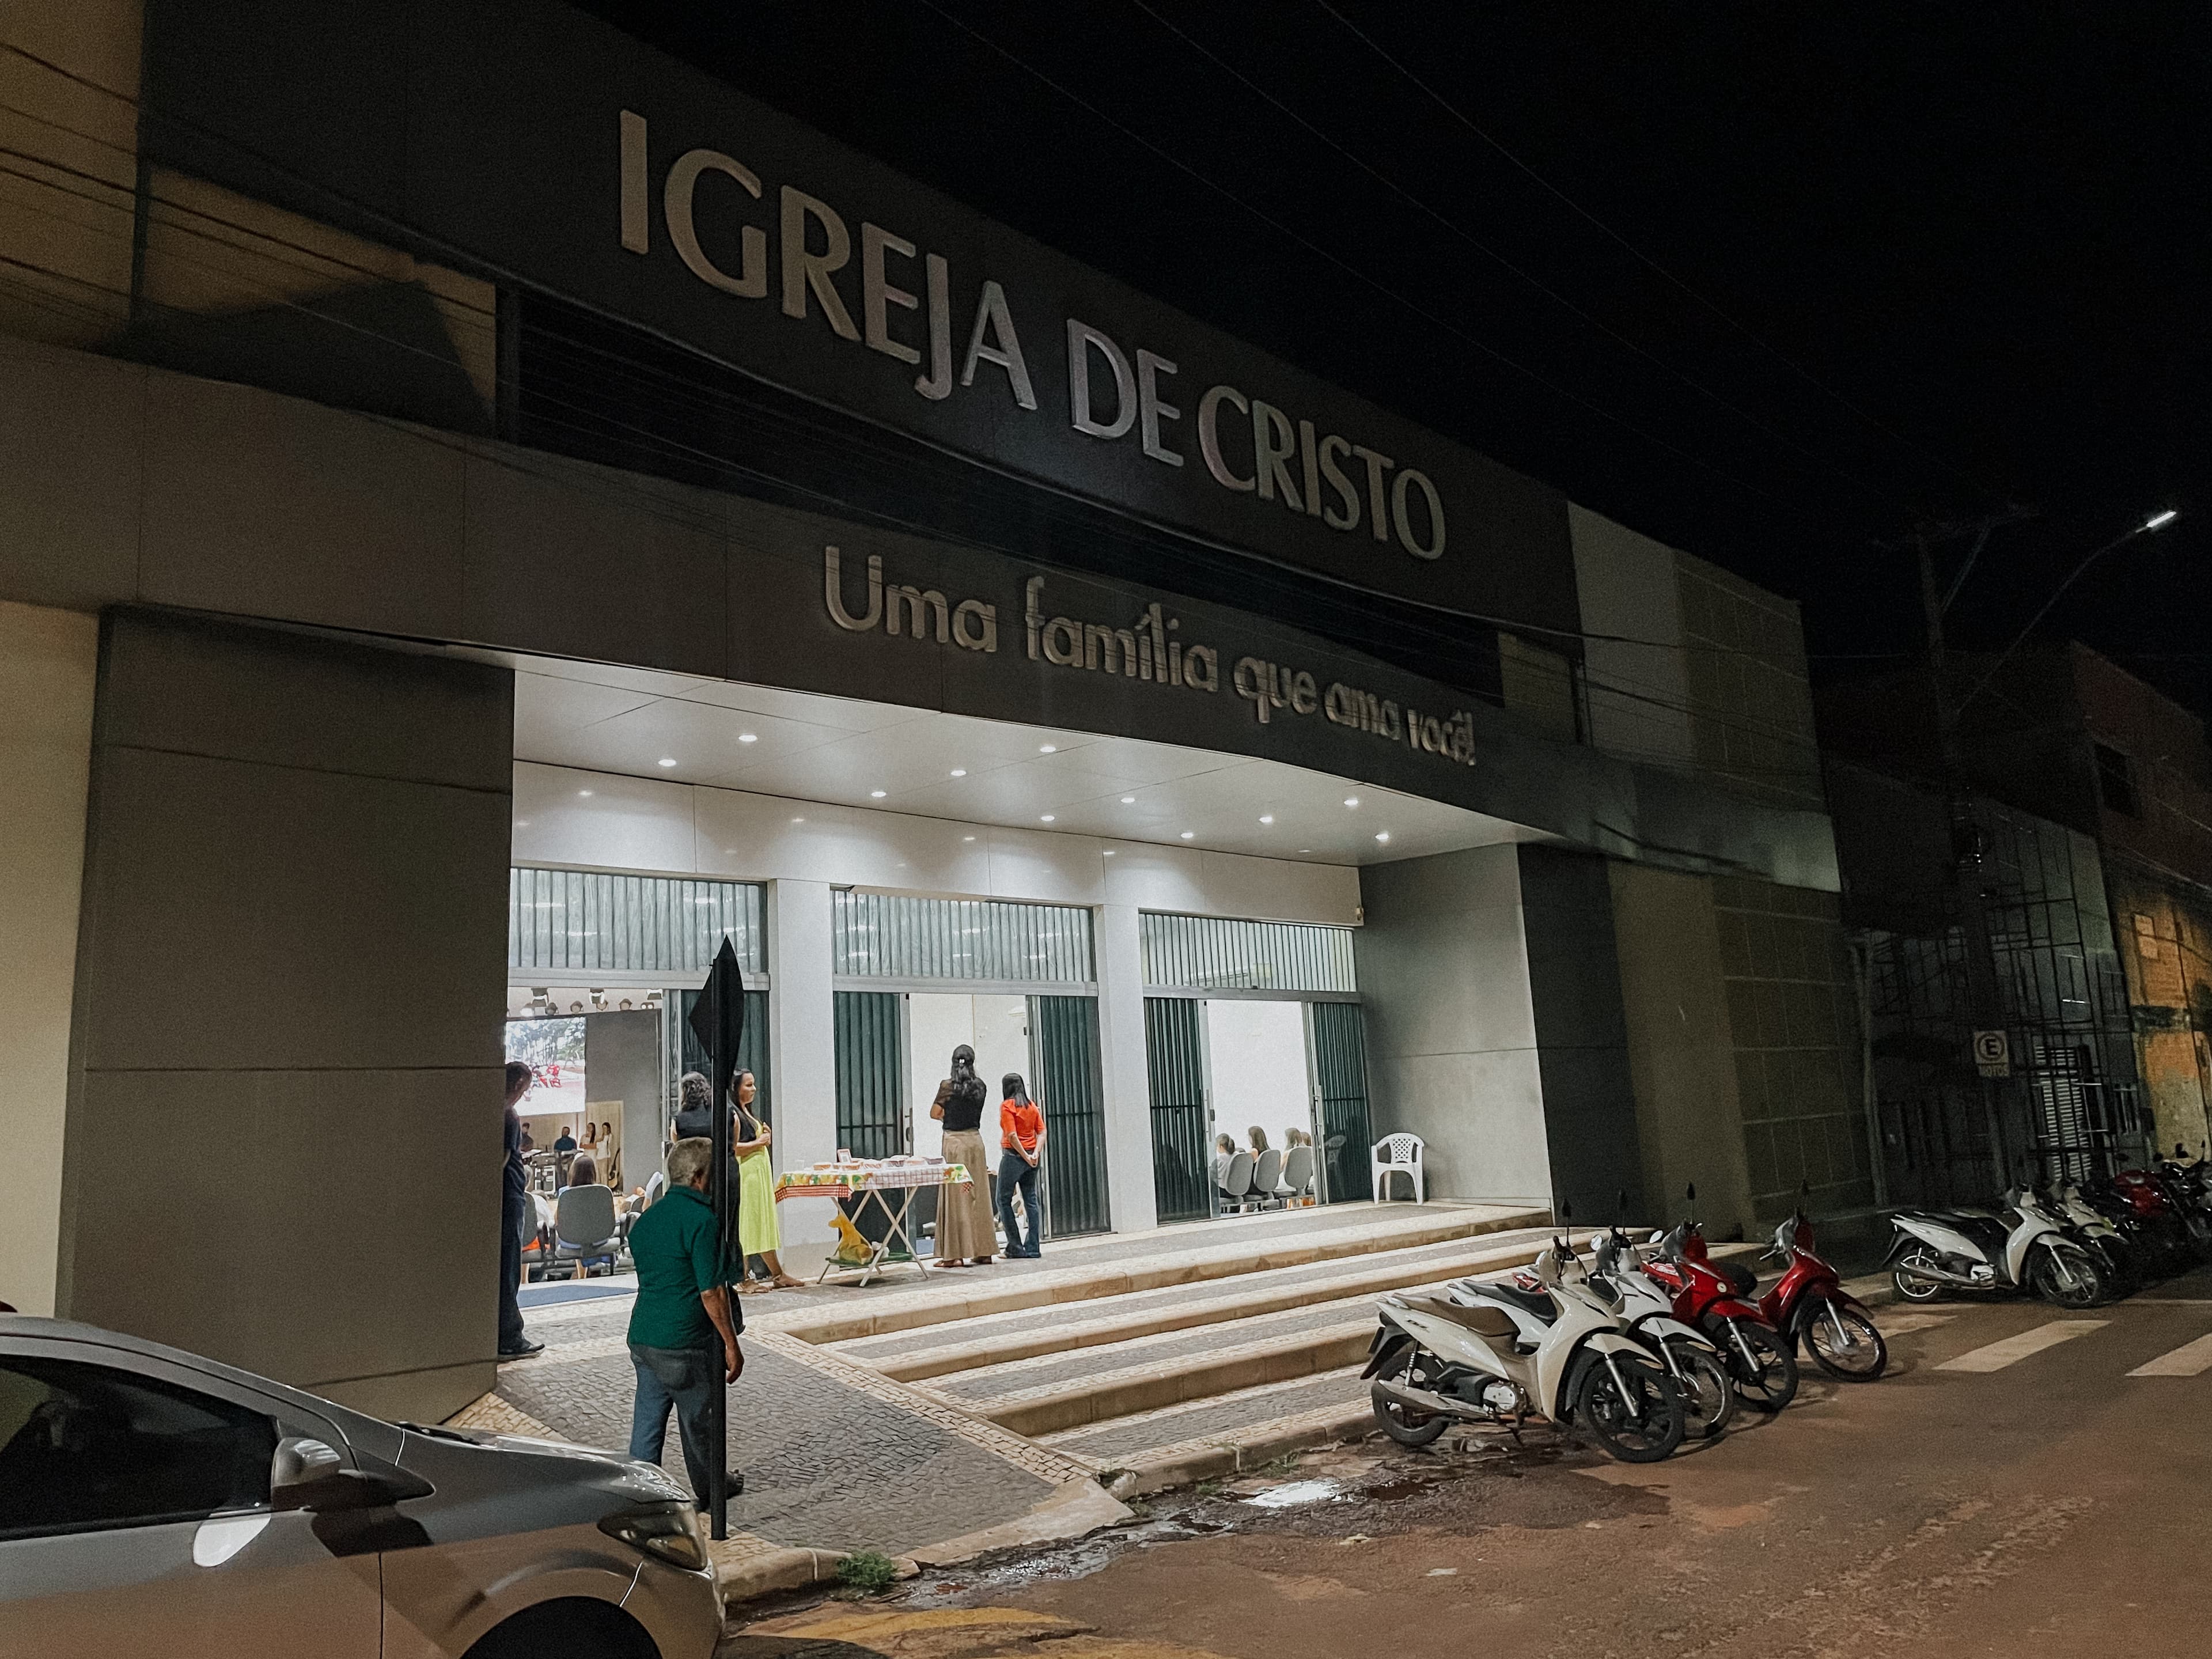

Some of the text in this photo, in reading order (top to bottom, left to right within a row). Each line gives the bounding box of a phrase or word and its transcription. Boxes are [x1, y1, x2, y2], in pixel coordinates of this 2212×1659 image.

[620, 109, 1446, 560] IGREJA DE CRISTO
[825, 545, 997, 653] Uma
[1026, 576, 1218, 692] família
[1234, 656, 1317, 724] que
[1325, 682, 1402, 741] ama
[1985, 1039, 1998, 1055] E
